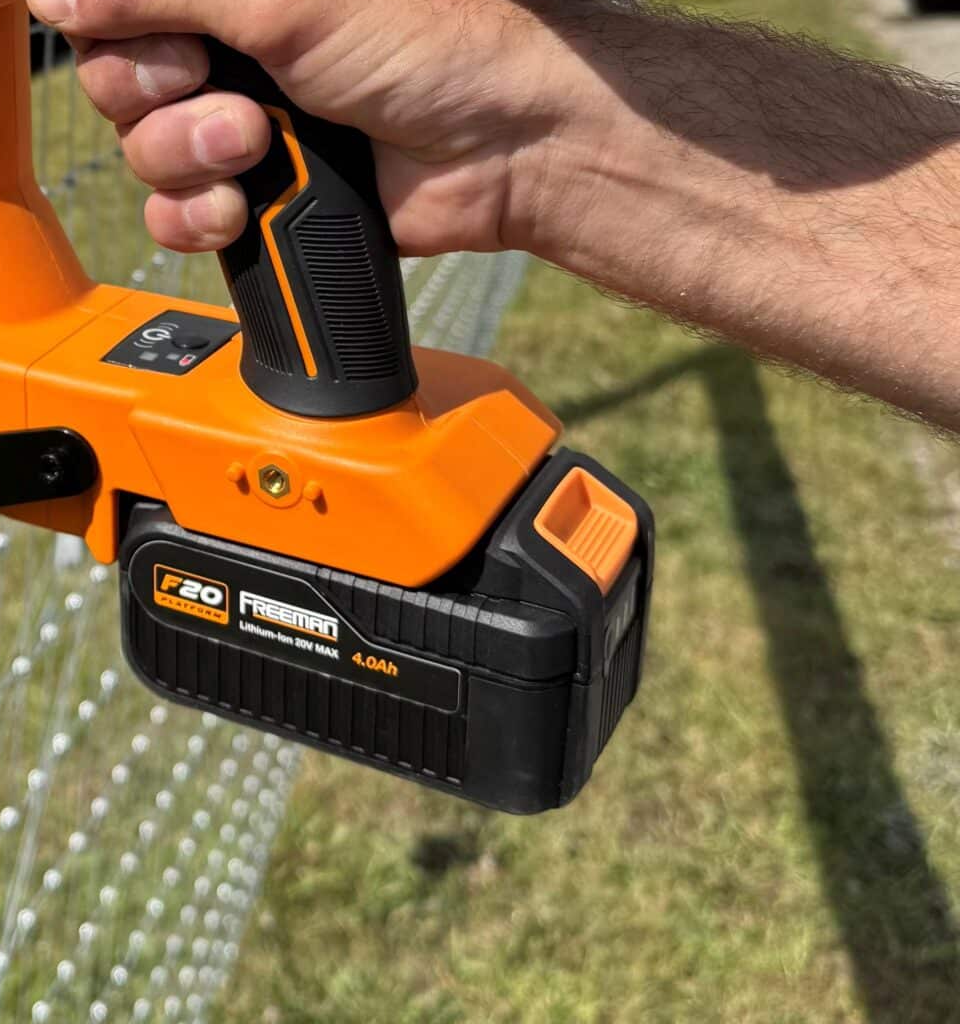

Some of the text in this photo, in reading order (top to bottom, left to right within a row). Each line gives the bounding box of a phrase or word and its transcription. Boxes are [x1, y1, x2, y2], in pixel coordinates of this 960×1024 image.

[161, 574, 223, 606] F20
[239, 590, 338, 642] FREEMAN
[239, 620, 339, 660] Lithium-Ion 20V MAX
[352, 652, 398, 676] 4.0Ah
